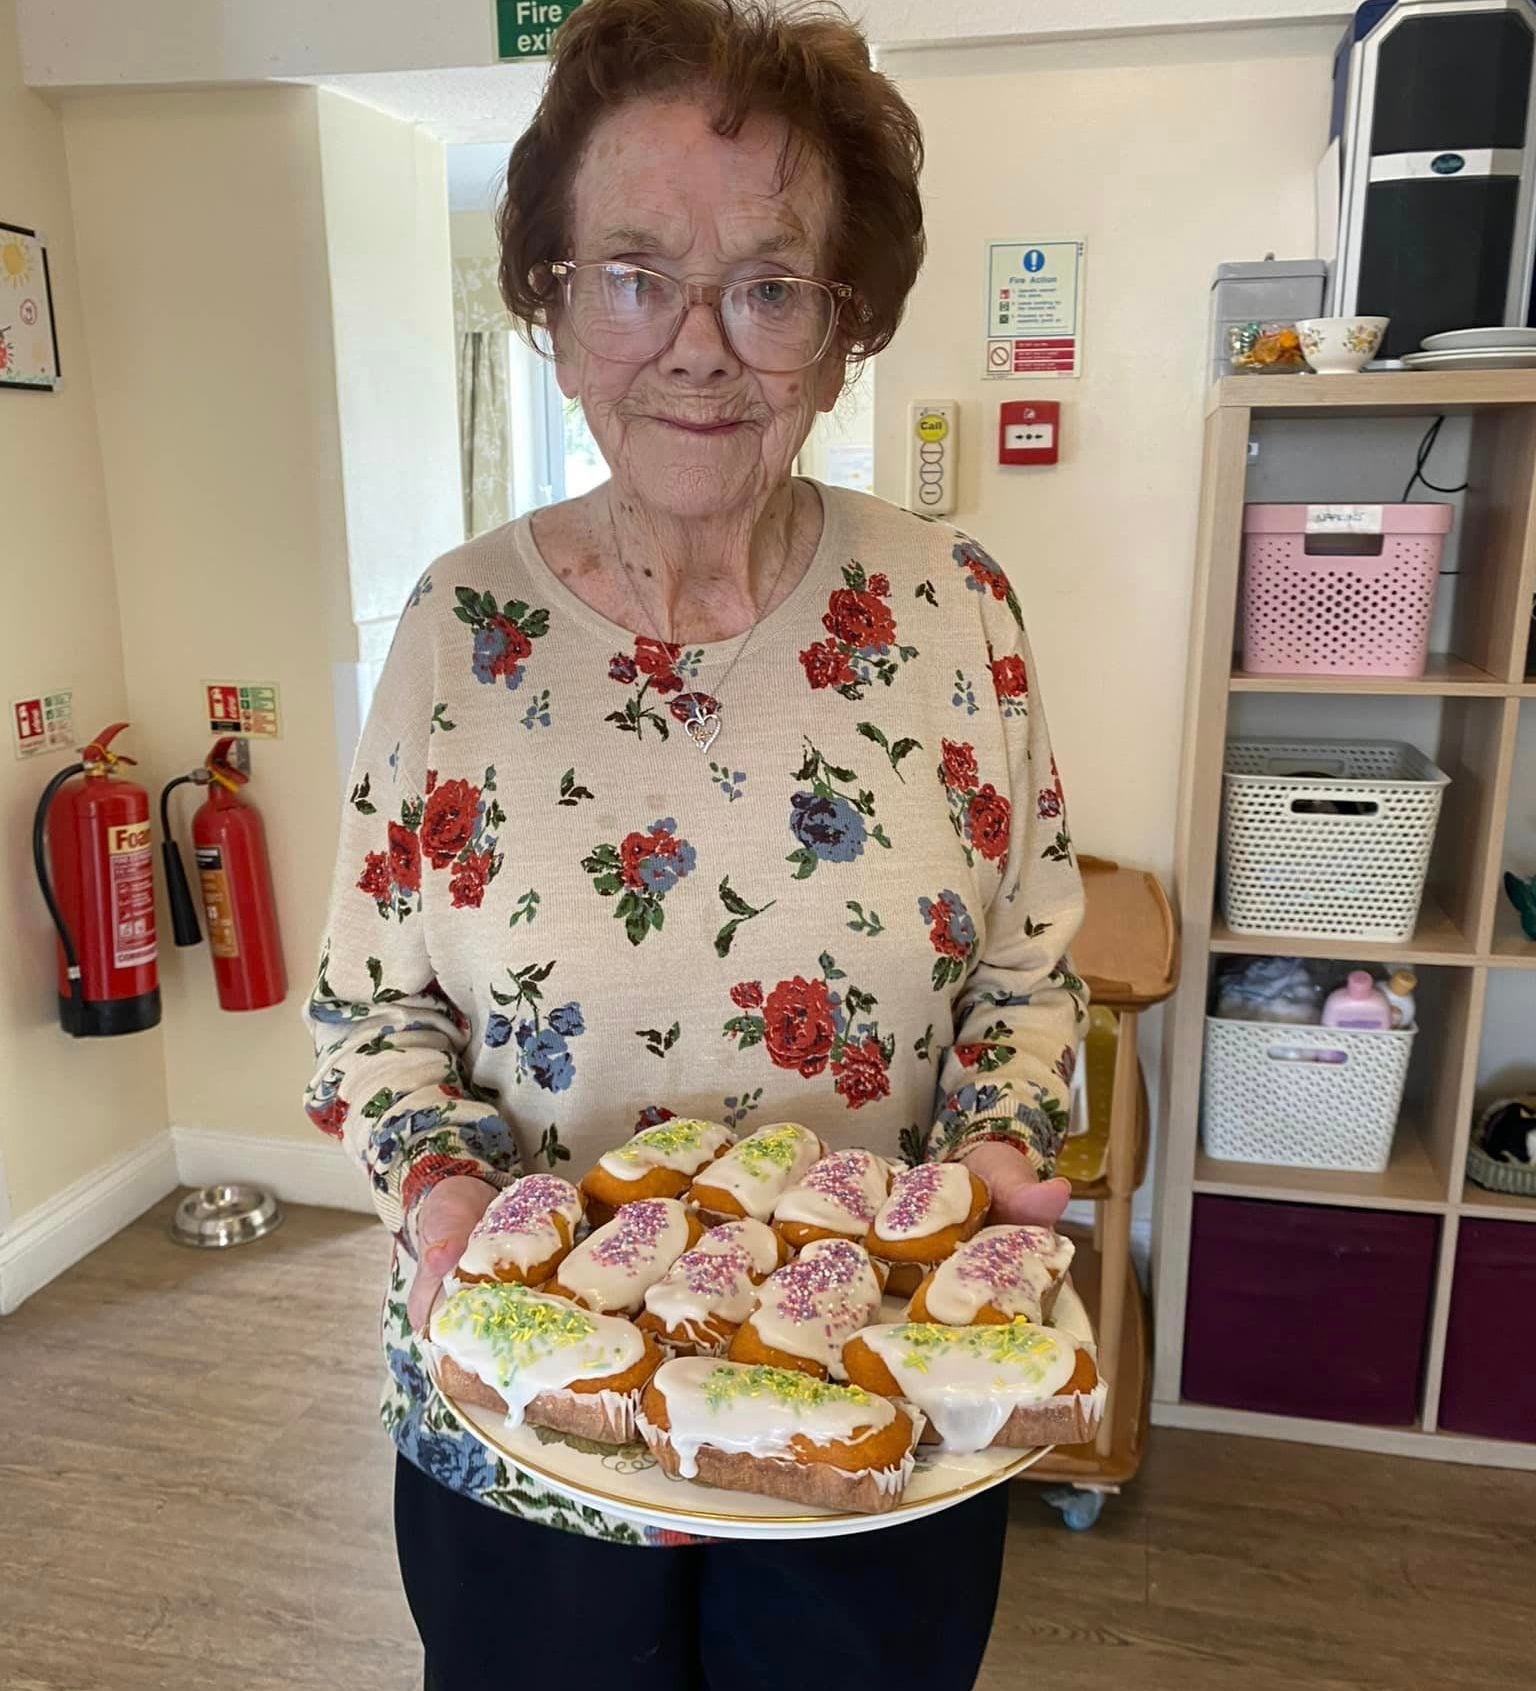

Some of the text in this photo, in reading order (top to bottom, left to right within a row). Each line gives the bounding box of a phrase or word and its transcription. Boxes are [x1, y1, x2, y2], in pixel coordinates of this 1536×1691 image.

[516, 1, 562, 25] Fire
[517, 28, 552, 52] exi
[920, 421, 943, 431] Call
[115, 828, 151, 850] Foa
